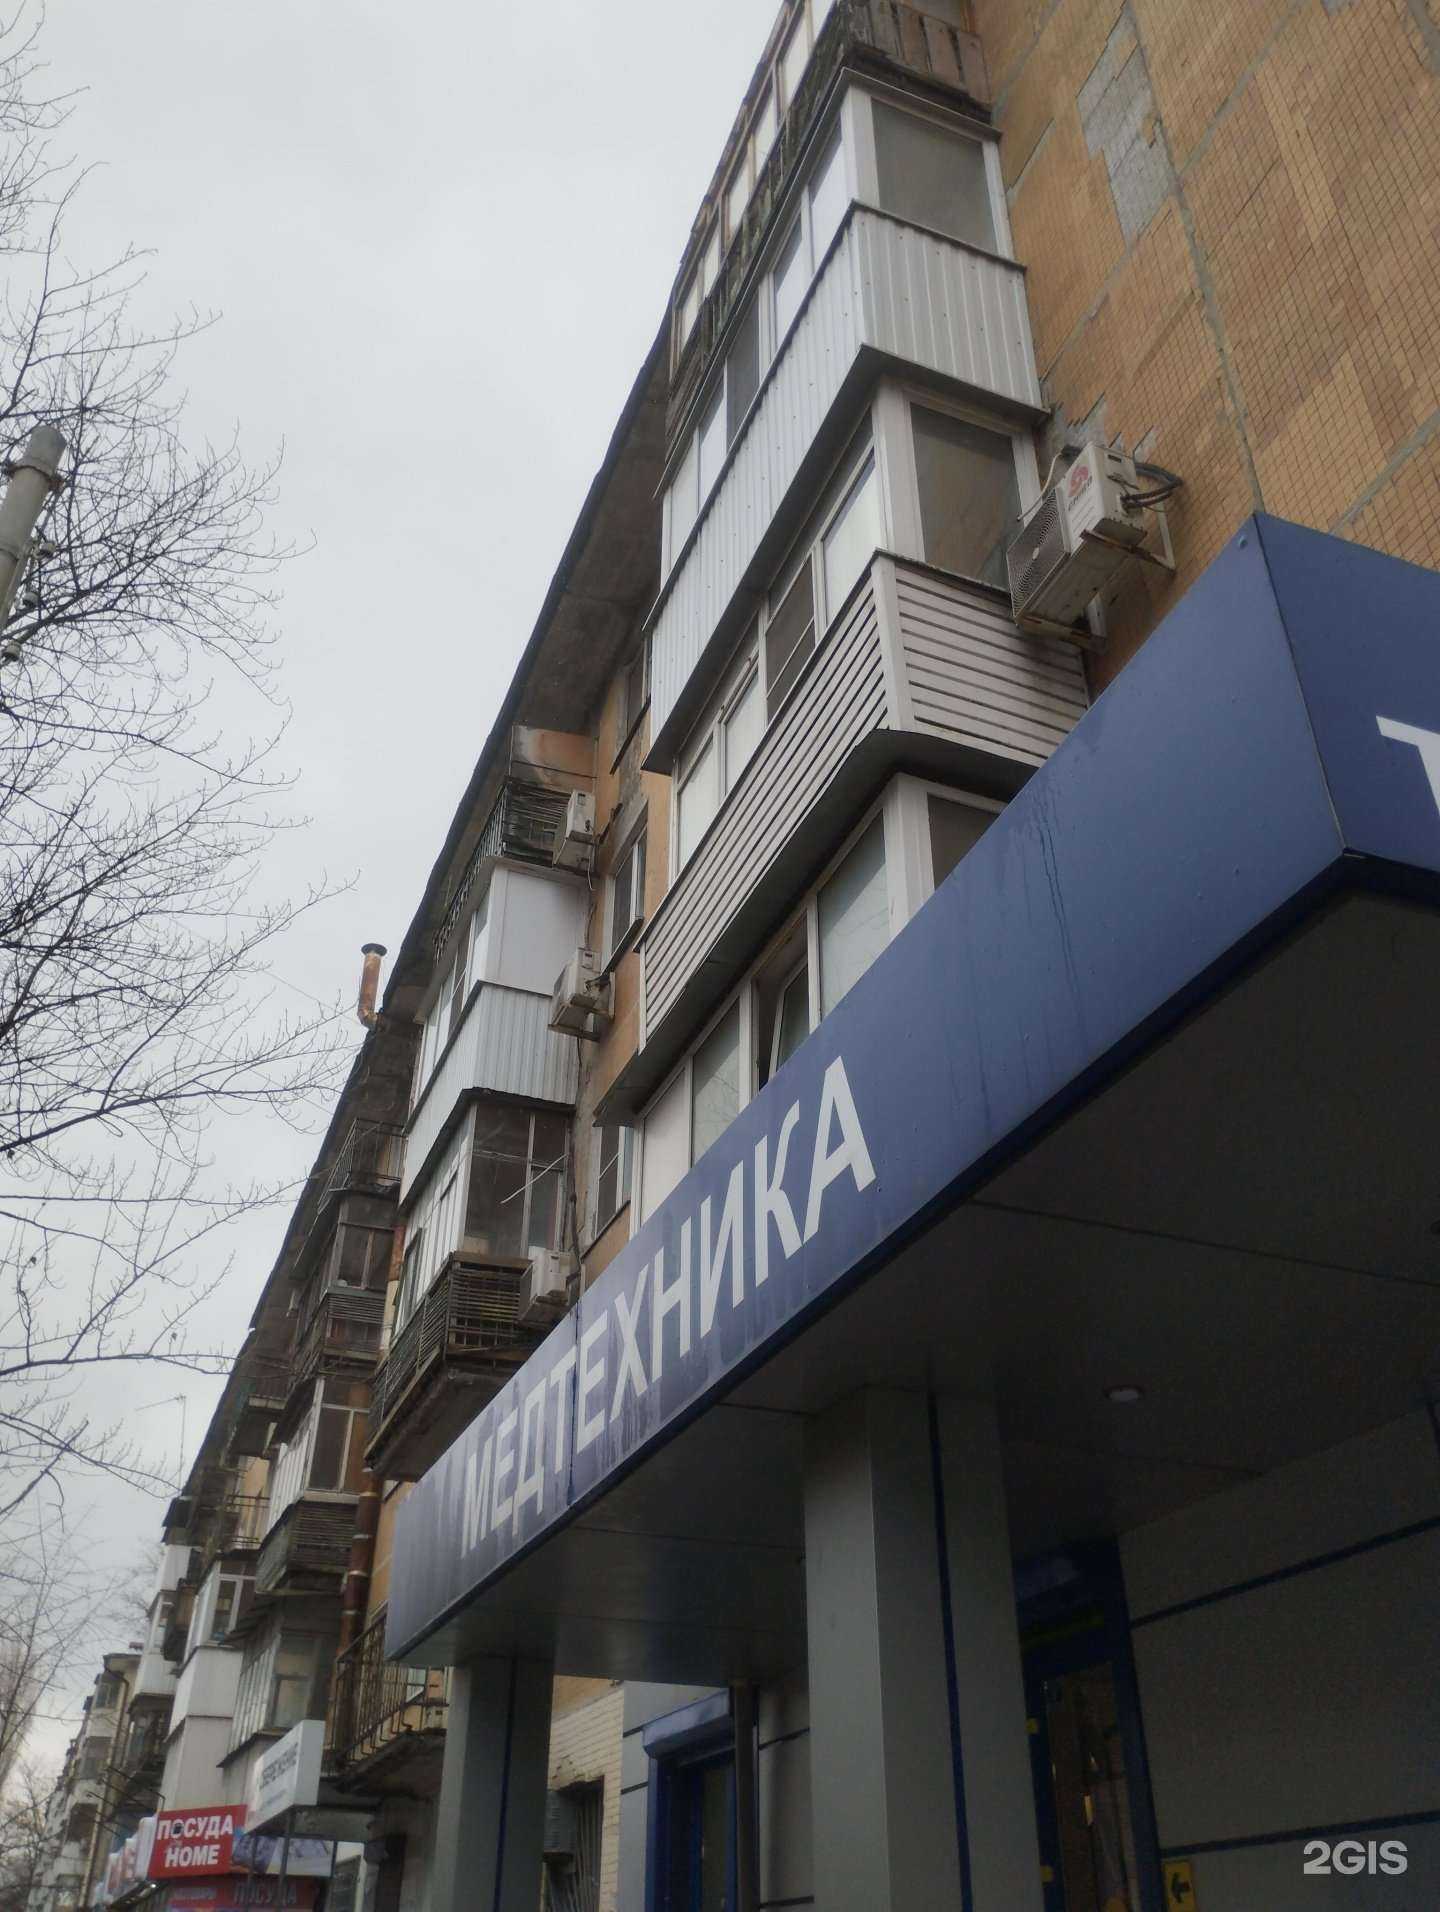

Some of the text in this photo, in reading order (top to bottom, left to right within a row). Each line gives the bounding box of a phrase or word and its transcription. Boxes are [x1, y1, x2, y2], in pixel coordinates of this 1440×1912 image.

[461, 1055, 876, 1559] МЕДТЕХНИКА
[157, 1814, 233, 1840] ПОСУДА
[164, 1844, 220, 1868] HOME
